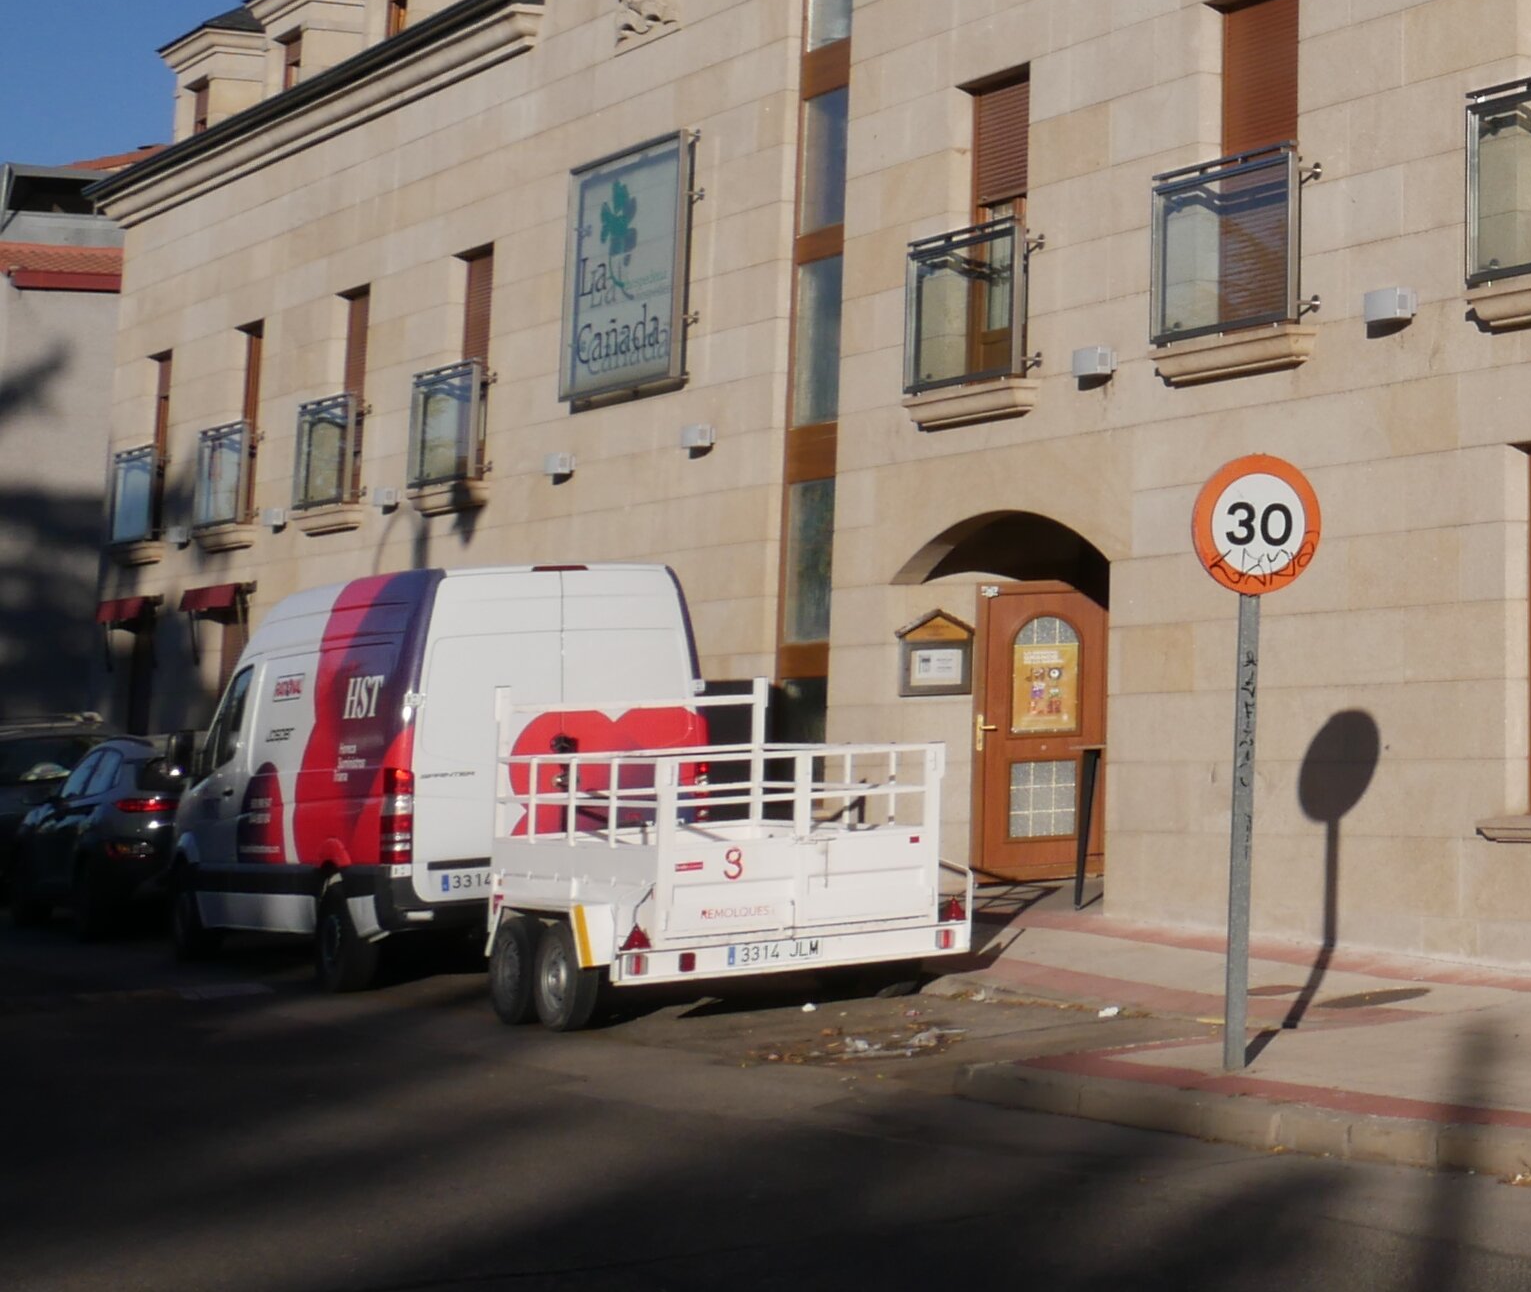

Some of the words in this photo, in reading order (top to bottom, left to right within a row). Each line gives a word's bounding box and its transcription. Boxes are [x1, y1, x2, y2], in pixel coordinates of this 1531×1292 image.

[579, 257, 607, 297] La
[577, 302, 660, 364] Cañada
[1225, 501, 1293, 546] 30
[343, 674, 385, 719] HST
[452, 873, 491, 890] 3314
[723, 846, 743, 880] 3
[701, 905, 770, 920] REMOLQUES
[741, 944, 780, 963] 3314
[789, 940, 820, 957] JLM
